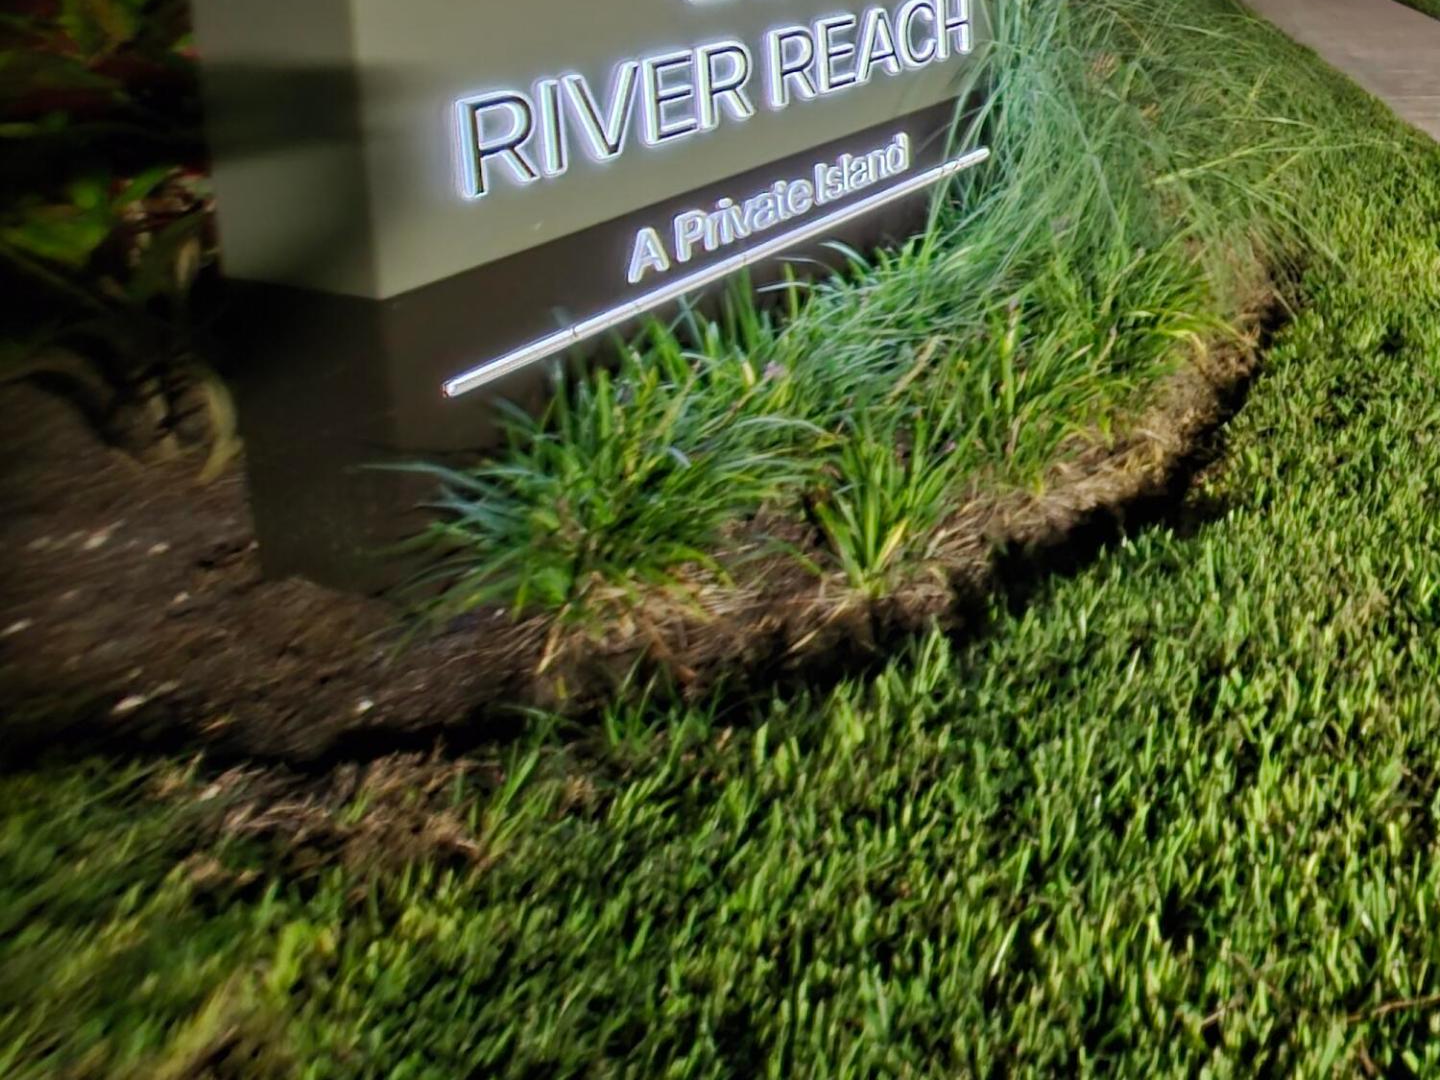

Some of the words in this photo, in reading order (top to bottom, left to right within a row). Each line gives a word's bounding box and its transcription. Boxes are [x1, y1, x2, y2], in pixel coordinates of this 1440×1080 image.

[453, 39, 755, 200] RIVER
[627, 227, 669, 283] A
[674, 177, 813, 262] Private
[813, 132, 909, 206] Island
